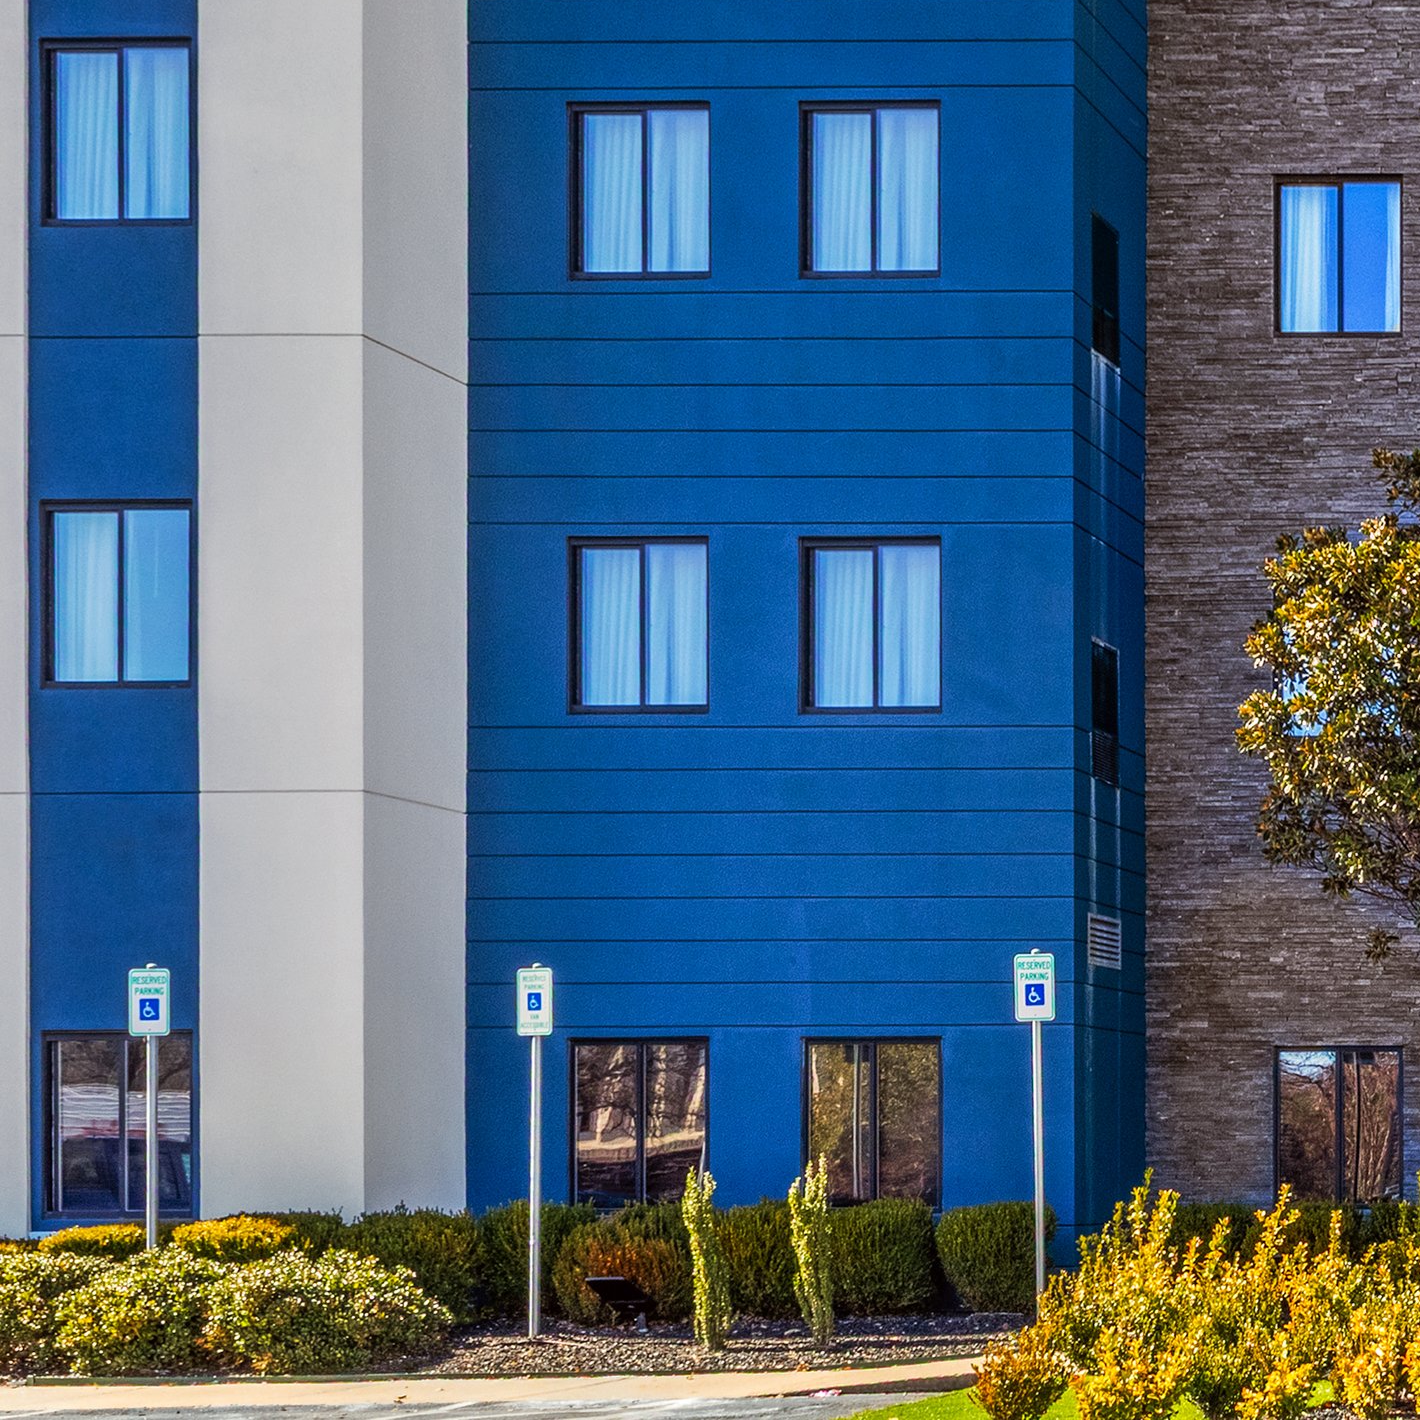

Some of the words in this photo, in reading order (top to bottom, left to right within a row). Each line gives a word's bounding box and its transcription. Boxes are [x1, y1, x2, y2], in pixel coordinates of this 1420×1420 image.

[1017, 961, 1051, 970] RESERVED
[131, 975, 168, 984] RESERVED
[1020, 972, 1049, 981] PARKING
[134, 987, 164, 995] PARKING
